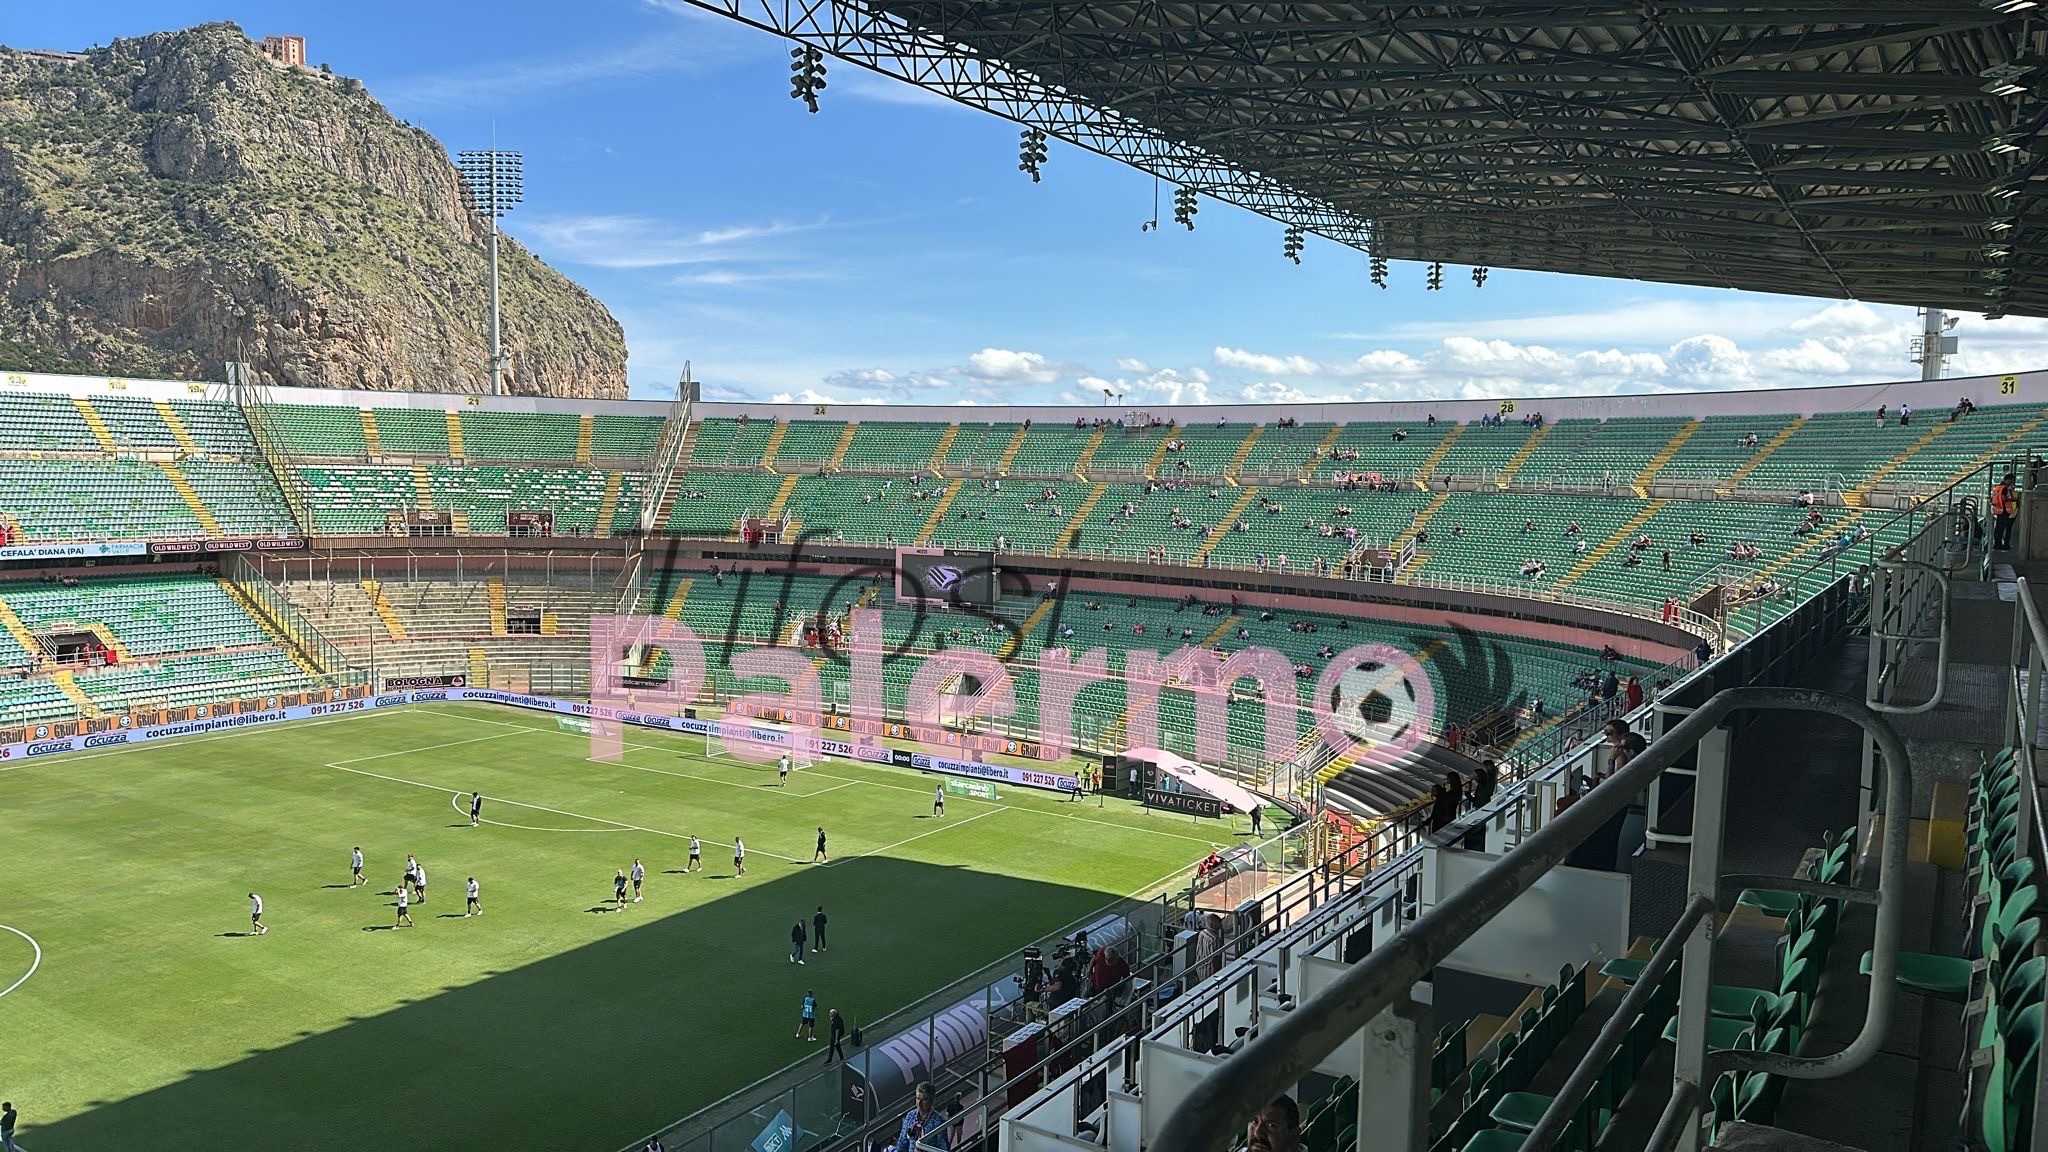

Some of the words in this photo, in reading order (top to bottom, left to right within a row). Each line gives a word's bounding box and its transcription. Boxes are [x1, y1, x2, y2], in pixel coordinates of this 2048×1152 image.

[2001, 381, 2015, 395] 31
[468, 397, 479, 406] 21
[1500, 403, 1514, 413] 28
[814, 406, 826, 415] 24
[1, 548, 37, 558] CEFALA'
[38, 547, 65, 556] DIANA
[67, 546, 85, 556] (PA)
[387, 677, 443, 687] BOLOGNA
[311, 705, 328, 715] 091
[329, 702, 346, 713] 227
[348, 700, 365, 710] 526
[462, 691, 556, 710] cocuzzaimpianti@libero.it
[572, 703, 585, 714] 091
[586, 705, 599, 715] 227
[600, 706, 613, 717] 526
[145, 711, 287, 738] cocuzzaimpianti@libero.it
[805, 739, 819, 749] 091
[821, 741, 837, 752] 227
[838, 744, 854, 754] 526
[894, 754, 910, 763] 00:00
[937, 760, 1009, 779] cocuzzaimpianti@libero.it
[1022, 772, 1033, 783] 091
[1033, 773, 1044, 784] 227
[1044, 775, 1056, 786] 526
[1057, 777, 1075, 790] Cocuzz
[1147, 791, 1218, 813] VIVATICKET
[878, 1003, 988, 1086] PUMA
